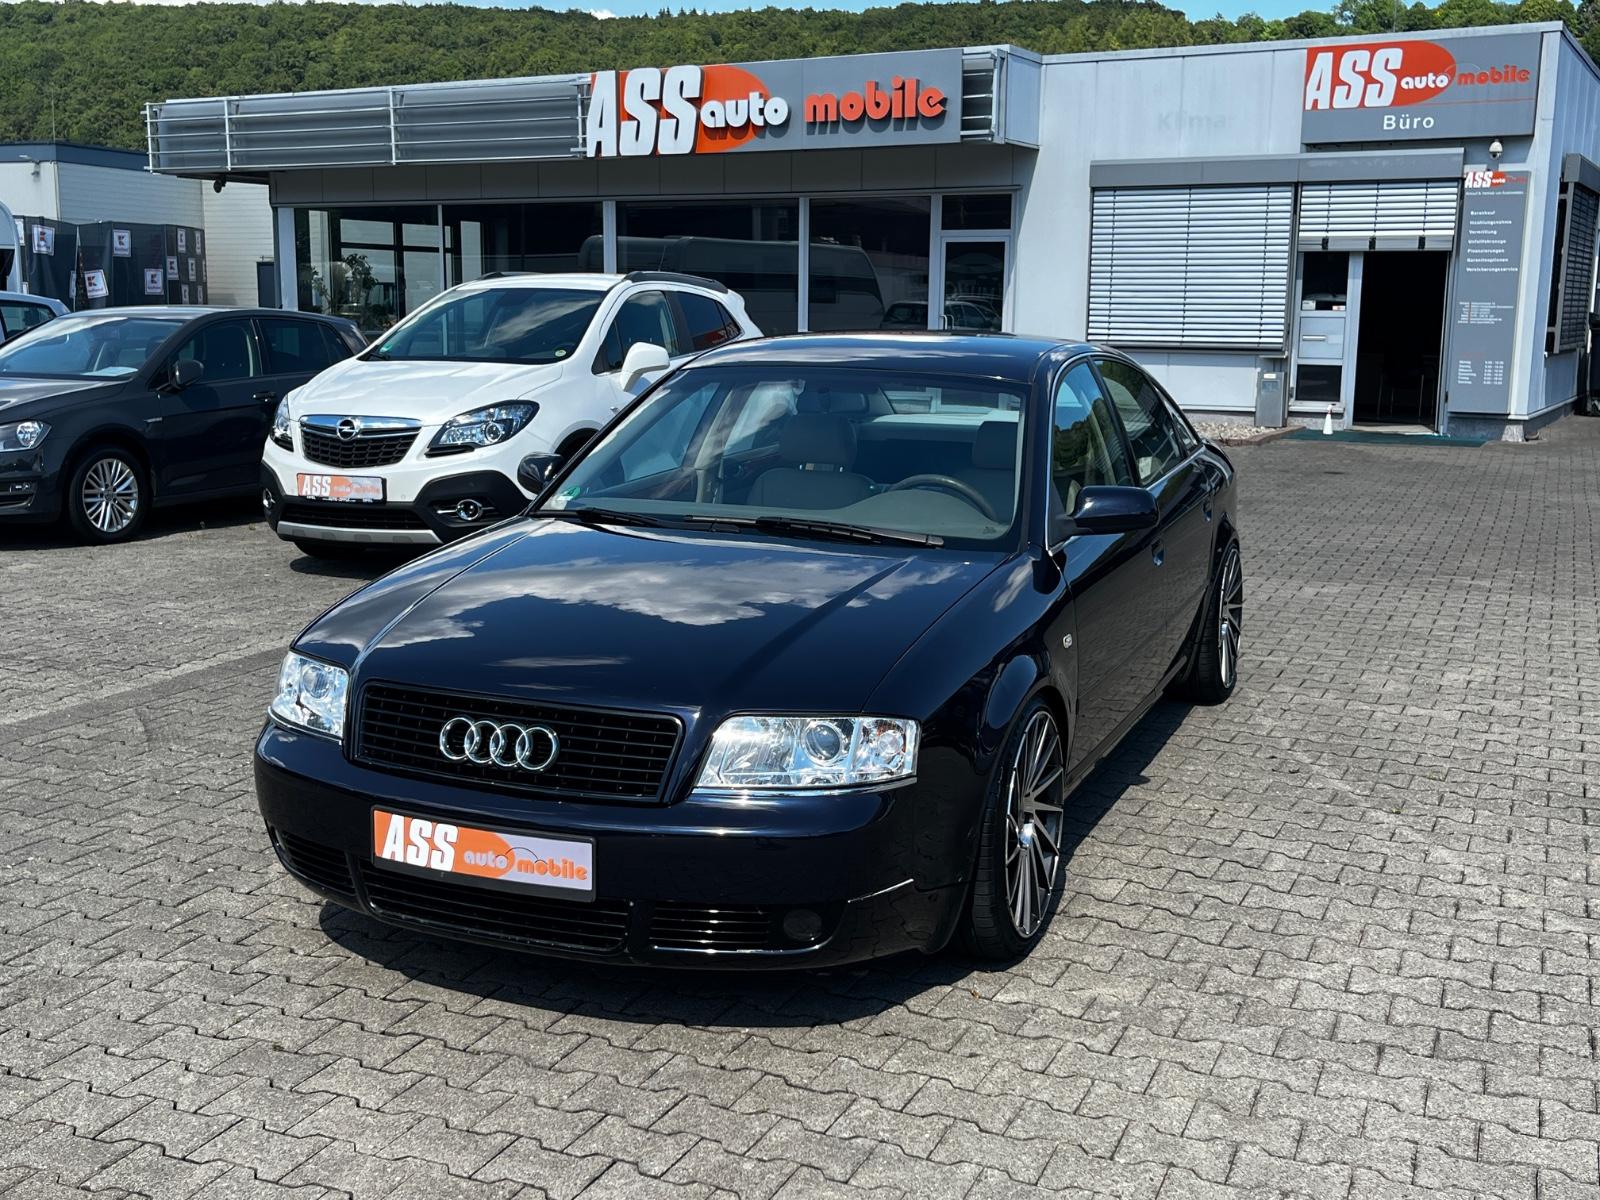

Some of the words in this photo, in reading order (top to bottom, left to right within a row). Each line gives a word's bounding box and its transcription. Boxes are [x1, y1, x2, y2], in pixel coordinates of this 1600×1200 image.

[1304, 48, 1403, 111] ASS
[1400, 72, 1449, 90] auto
[1456, 65, 1530, 86] mobile
[586, 65, 701, 157] ASS
[700, 91, 788, 128] auto
[804, 75, 946, 123] mobile
[1383, 115, 1435, 130] Büro
[1464, 171, 1493, 188] ASS
[302, 475, 332, 497] ASS
[380, 813, 458, 871] ASS
[463, 850, 508, 869] auto
[517, 857, 588, 881] mobile
